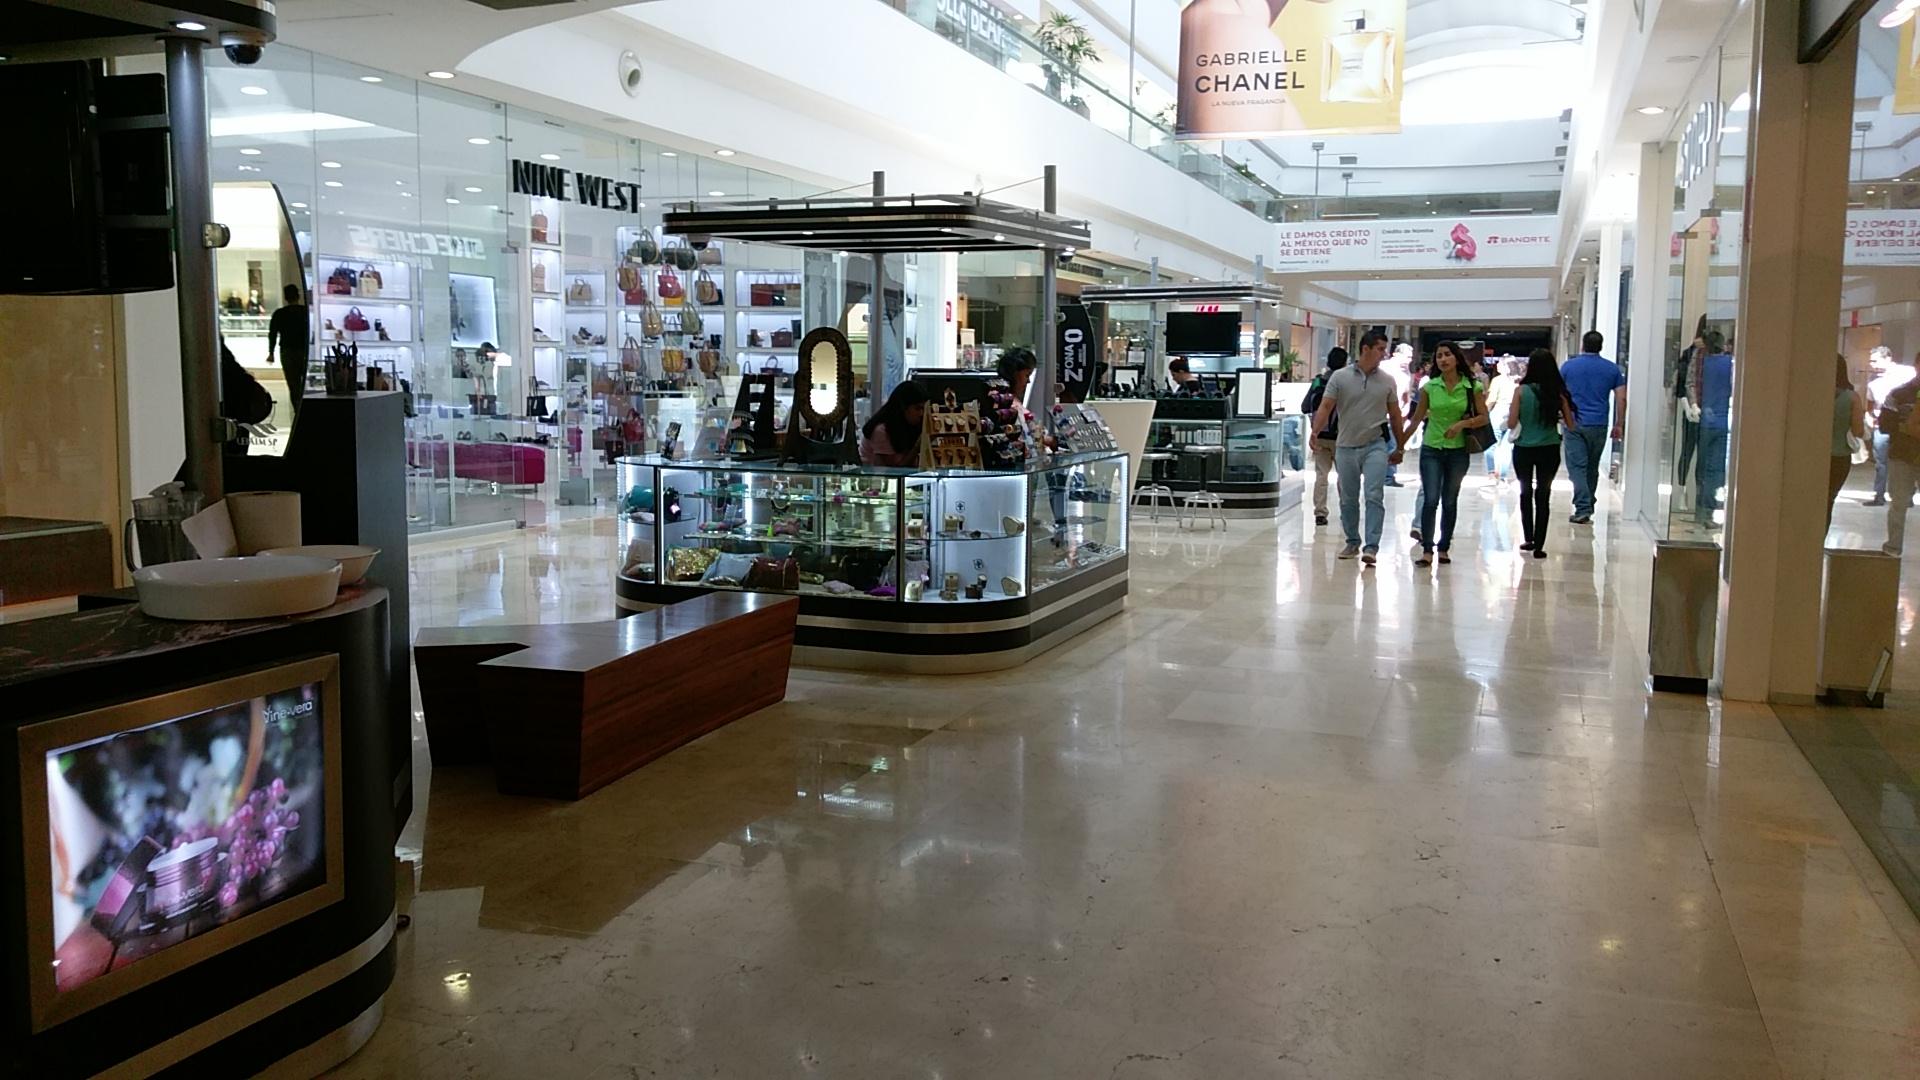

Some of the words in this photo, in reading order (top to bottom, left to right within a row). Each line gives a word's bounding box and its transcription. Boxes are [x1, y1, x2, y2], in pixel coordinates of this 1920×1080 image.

[1196, 49, 1307, 67] GABRIELLE
[1195, 71, 1305, 93] CHANEL
[512, 159, 571, 201] NINE
[576, 172, 642, 213] WEST
[1294, 231, 1328, 239] DAMOS
[1354, 238, 1368, 246] NO
[1293, 248, 1332, 256] DETIENE
[1064, 344, 1084, 382] ZONA
